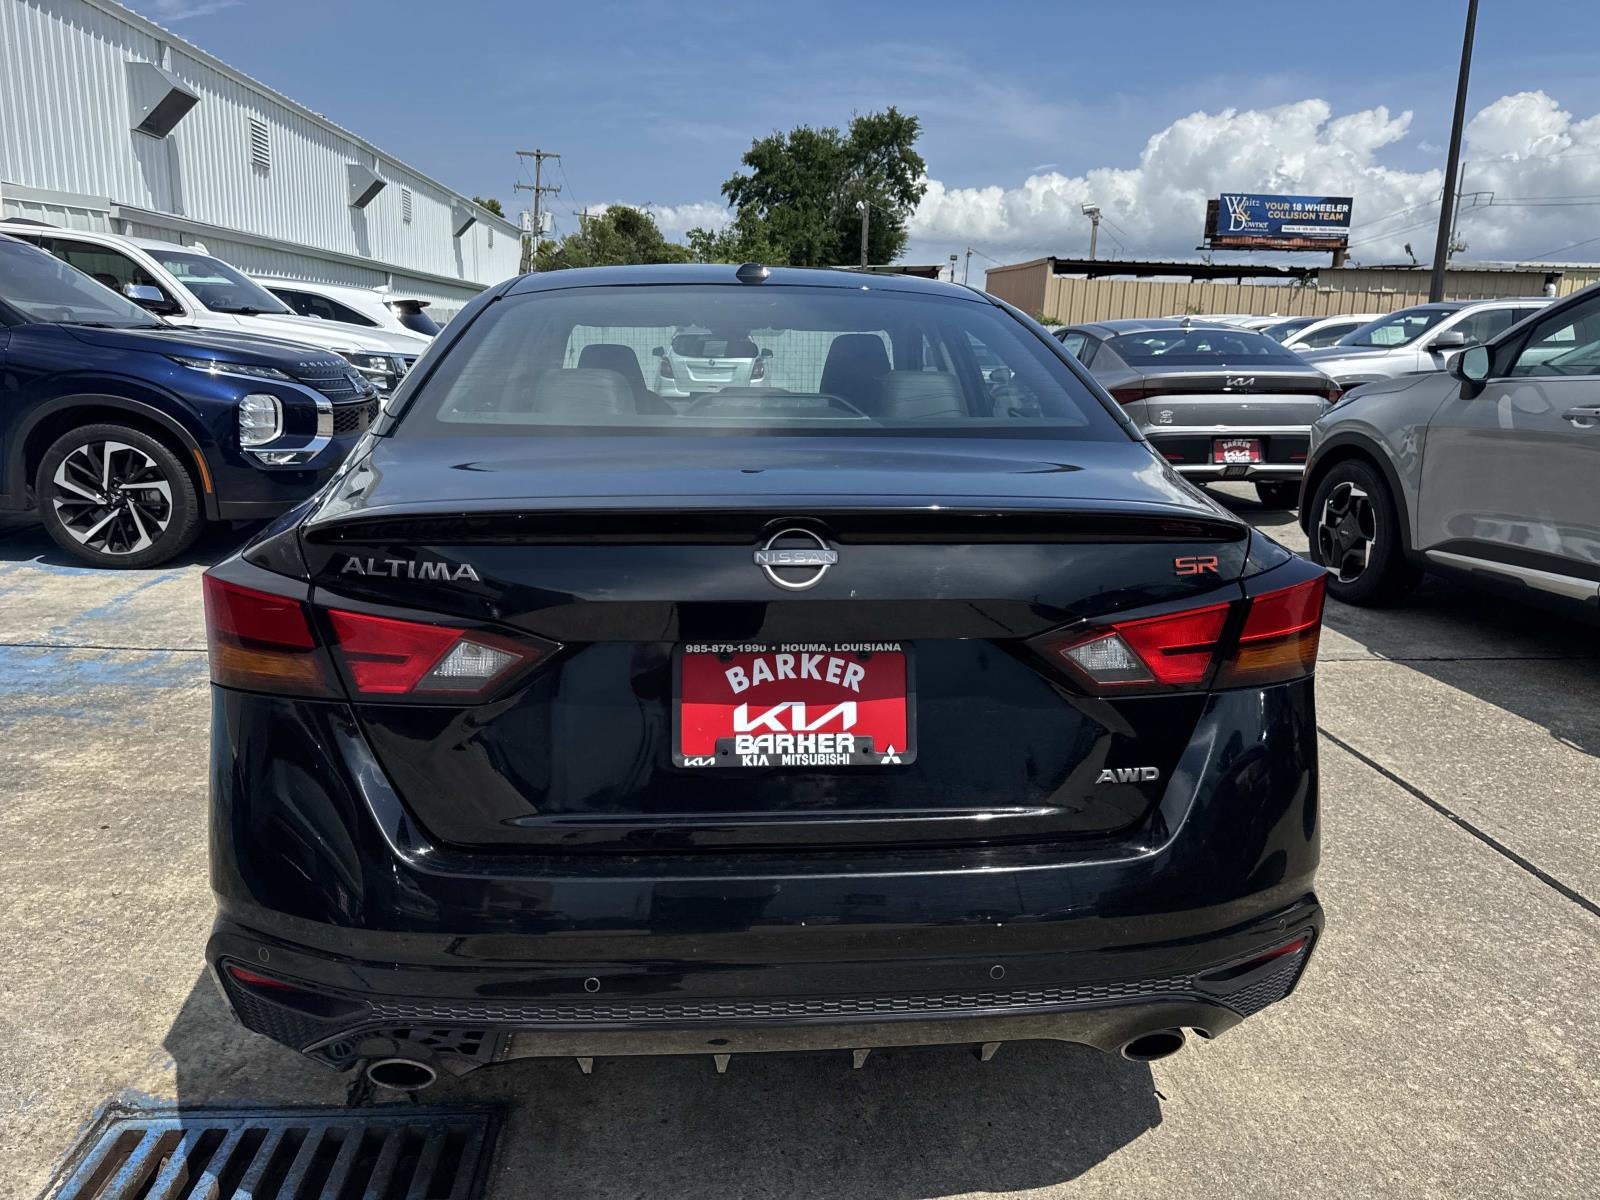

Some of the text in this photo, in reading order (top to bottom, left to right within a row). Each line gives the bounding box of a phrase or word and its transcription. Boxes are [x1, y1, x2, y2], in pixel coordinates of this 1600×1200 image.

[1265, 202, 1349, 213] YOUR 18 WHEELER
[1268, 210, 1344, 221] COLLISION TEAM
[1228, 213, 1269, 232] Downer
[756, 552, 836, 563] NISSAN
[1175, 556, 1218, 575] SR
[340, 557, 480, 582] ALTIMA
[781, 643, 831, 653] HOUMA,
[834, 642, 902, 652] LOUISIANA
[725, 653, 865, 694] BARKER
[733, 701, 857, 732] KIA
[735, 733, 855, 754] BARKER
[742, 754, 850, 766] KIA MITSUBISHI
[1095, 766, 1160, 784] AWD
